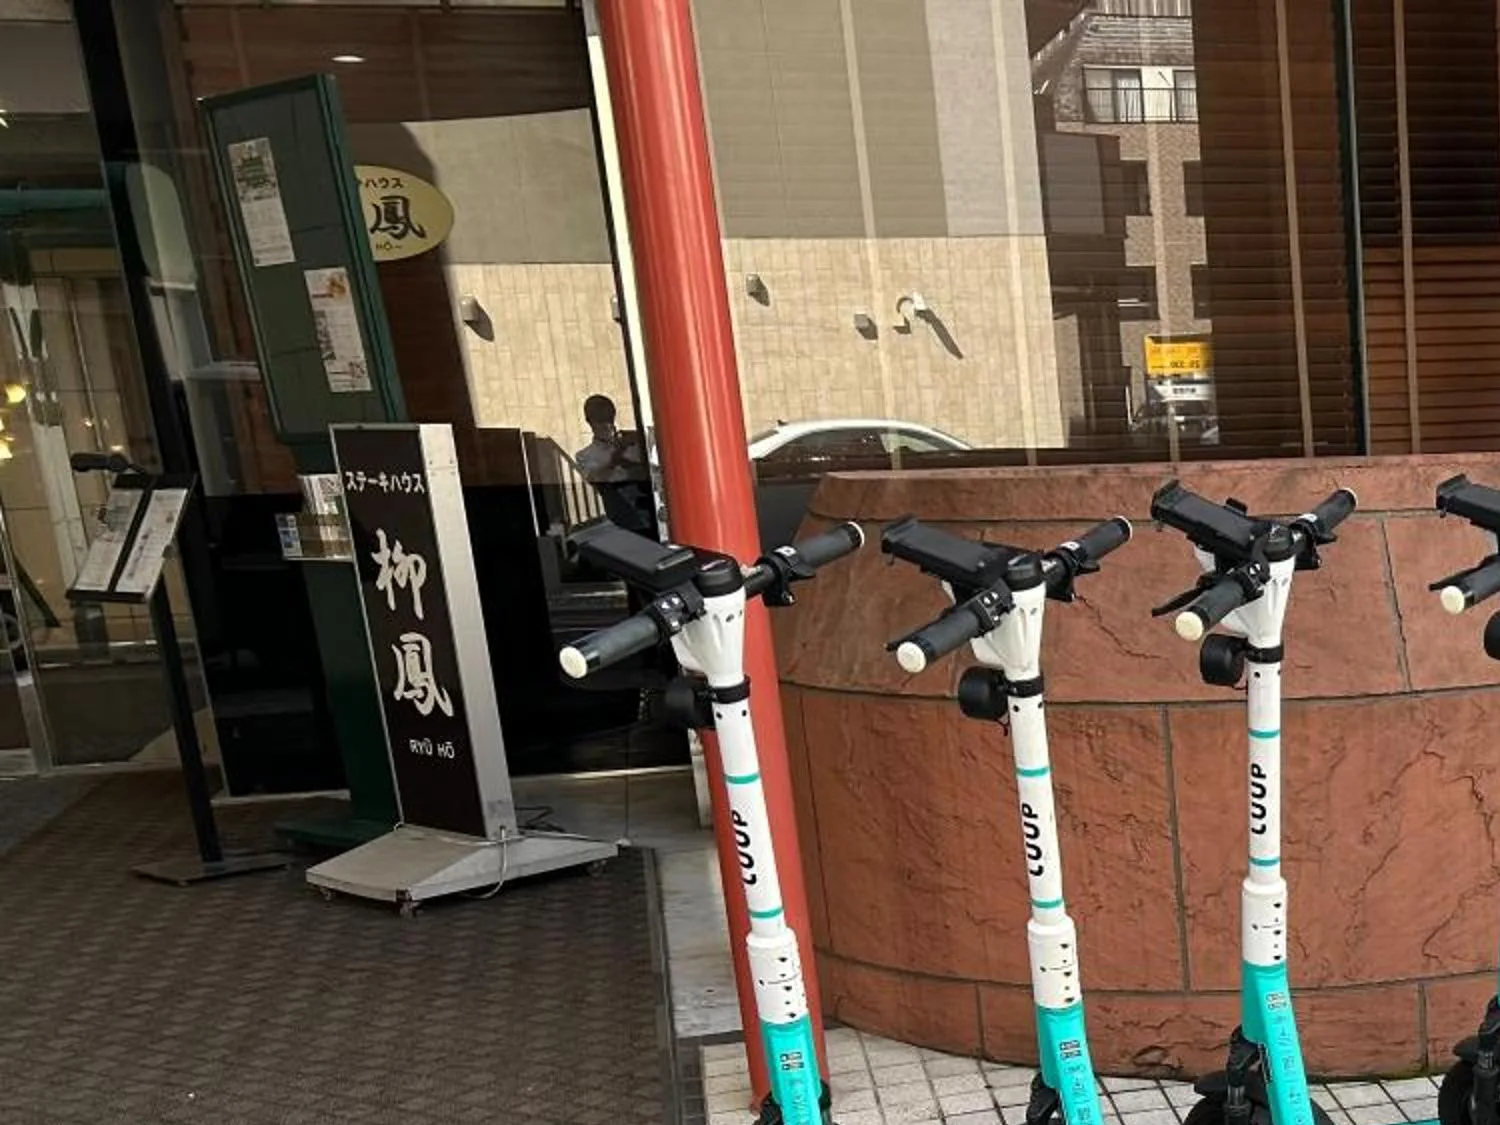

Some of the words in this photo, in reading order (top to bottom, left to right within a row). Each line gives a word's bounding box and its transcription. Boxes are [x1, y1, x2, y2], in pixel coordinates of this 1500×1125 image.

[364, 176, 404, 188] ハウス
[345, 471, 425, 493] ステーキハウス
[1251, 763, 1267, 835] LUUP
[731, 810, 757, 885] LUUP
[1022, 803, 1044, 876] LUUP
